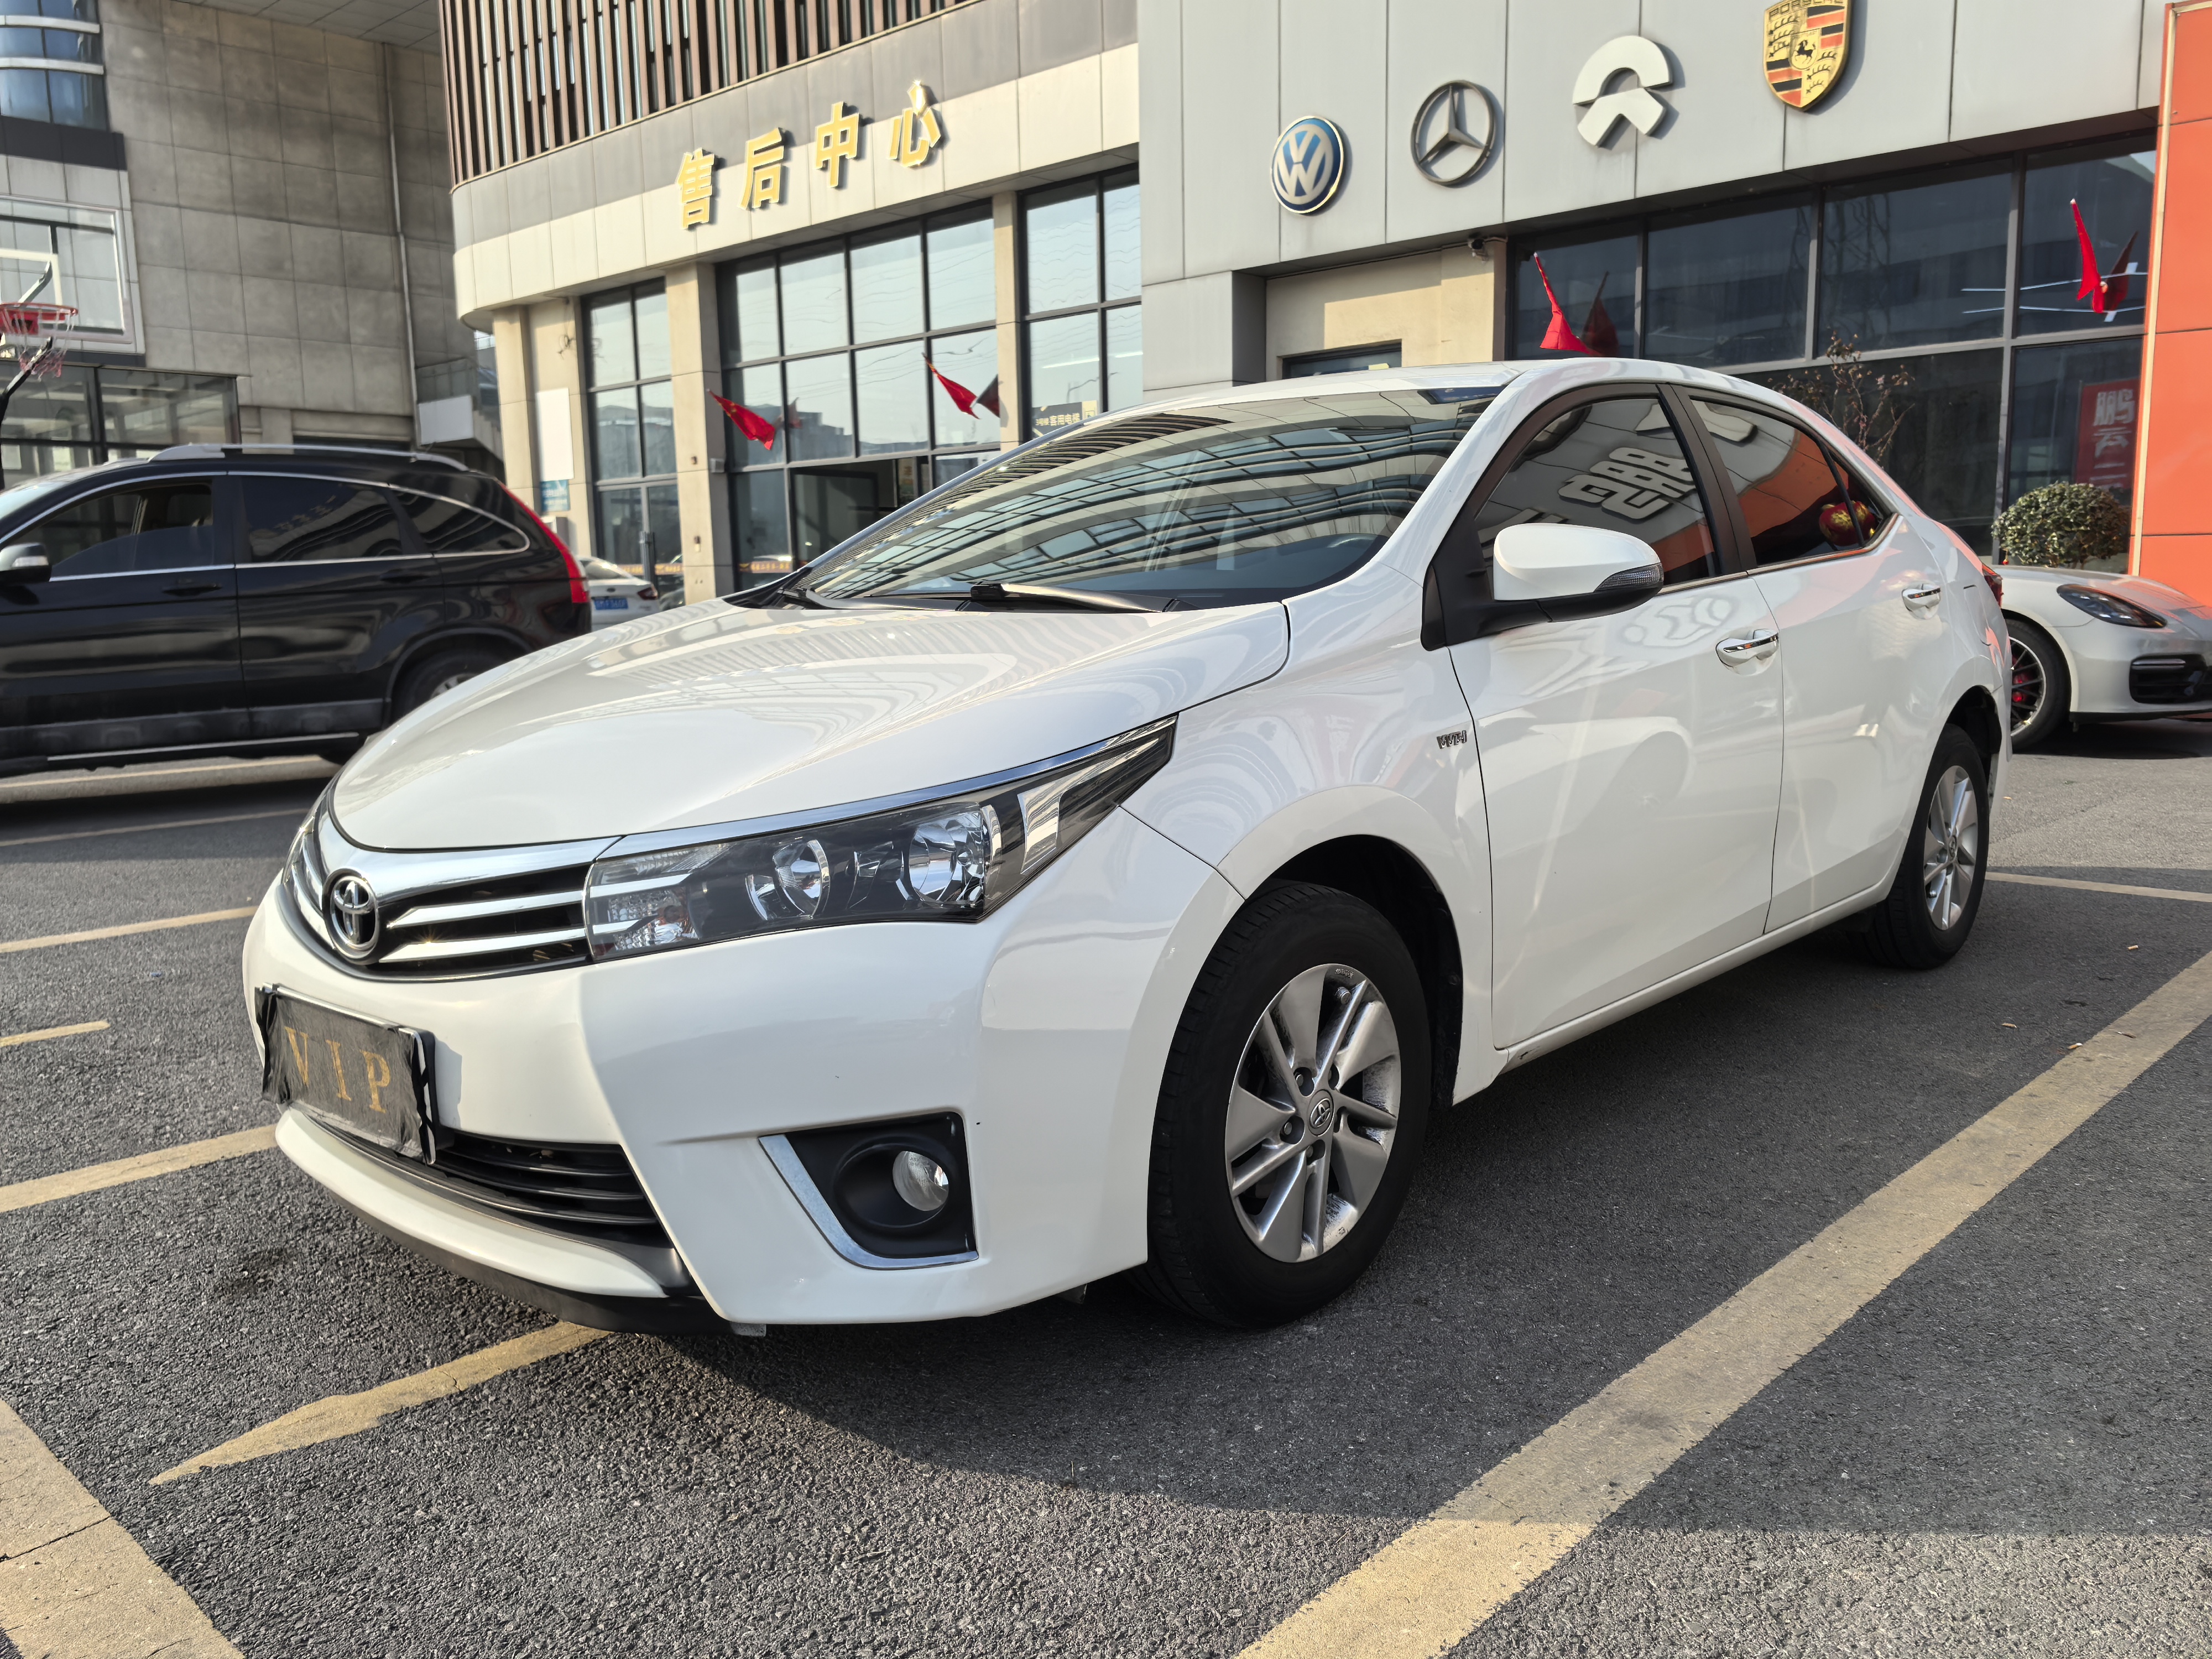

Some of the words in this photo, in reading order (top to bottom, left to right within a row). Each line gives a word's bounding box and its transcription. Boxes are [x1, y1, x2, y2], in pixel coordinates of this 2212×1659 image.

[675, 80, 941, 229] 售后中心
[284, 1025, 390, 1114] VIP
